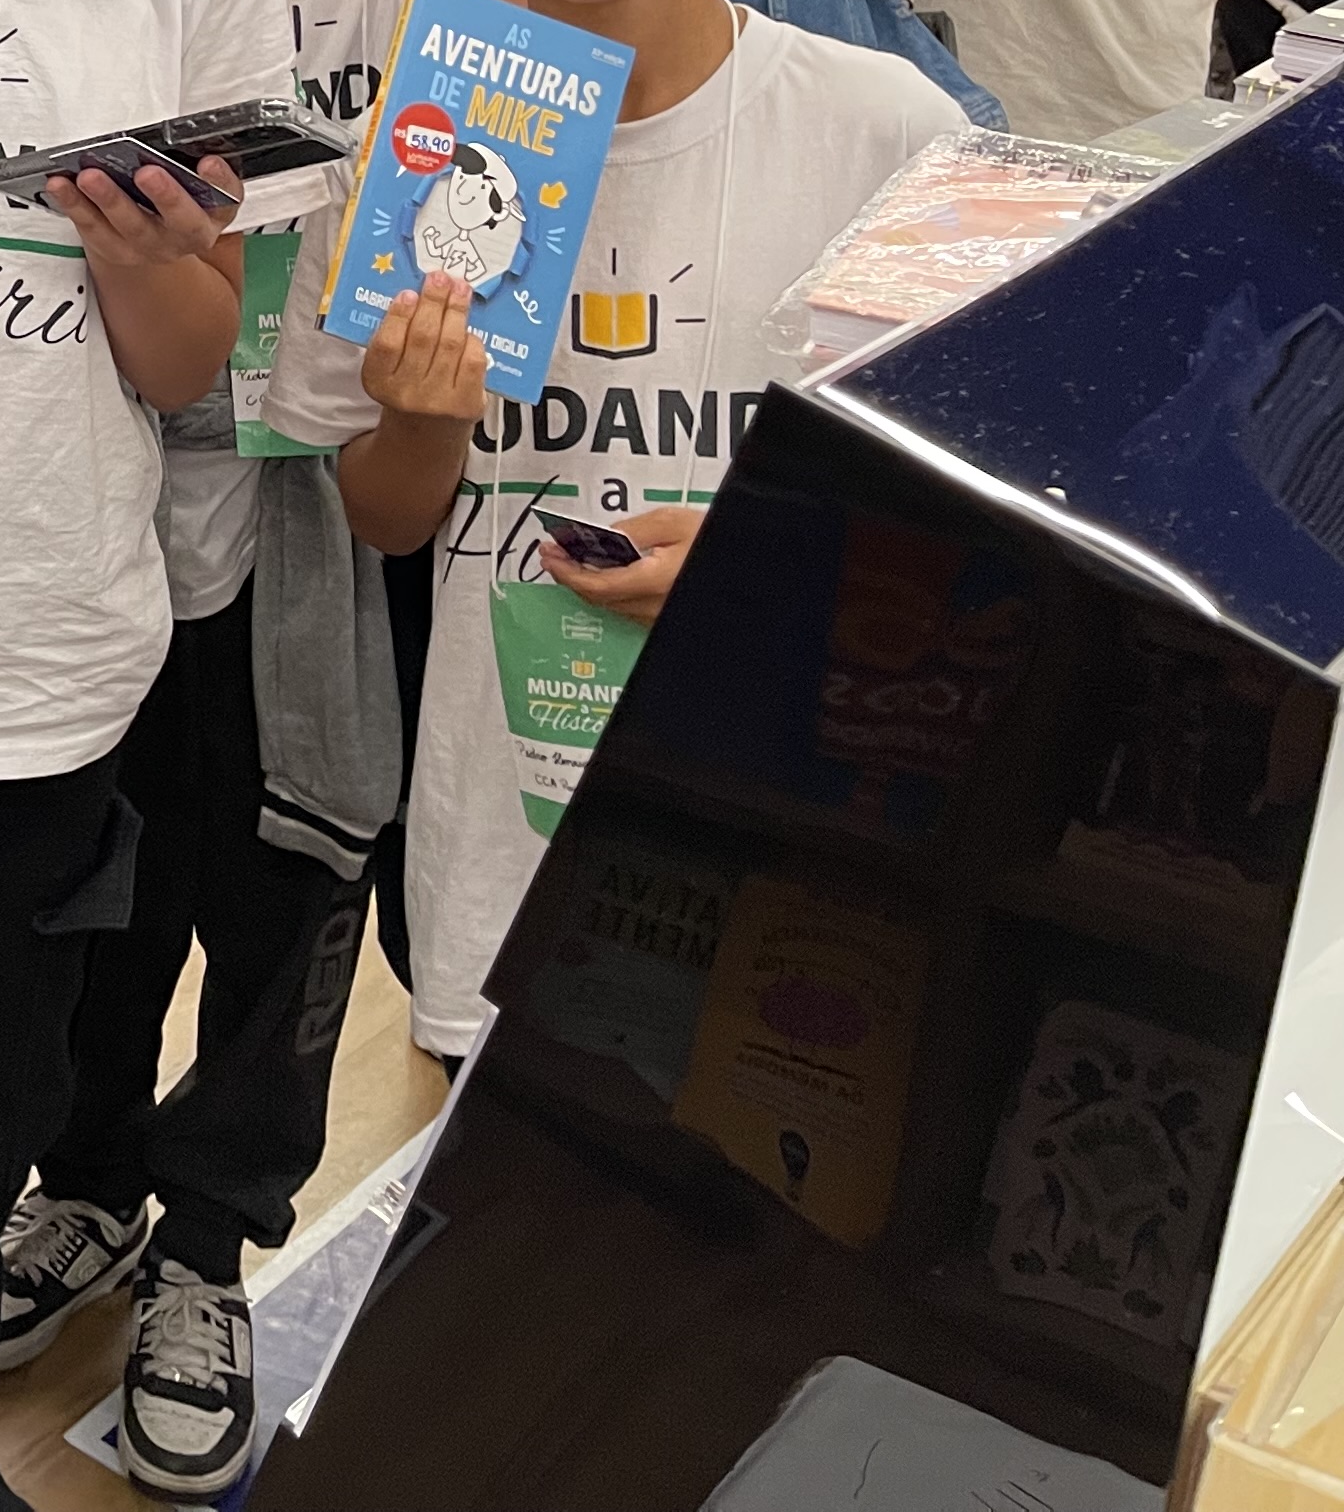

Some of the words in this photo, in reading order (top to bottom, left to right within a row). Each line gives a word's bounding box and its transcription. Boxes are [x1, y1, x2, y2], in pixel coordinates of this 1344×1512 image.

[504, 23, 532, 50] AS
[420, 23, 601, 116] AVENTURAS
[428, 70, 465, 109] DE
[465, 84, 563, 156] MIKE
[410, 134, 450, 153] 58,90
[471, 385, 770, 458] UDAND
[600, 477, 629, 513] a
[527, 678, 624, 704] MUDAND
[529, 700, 607, 734] Histó
